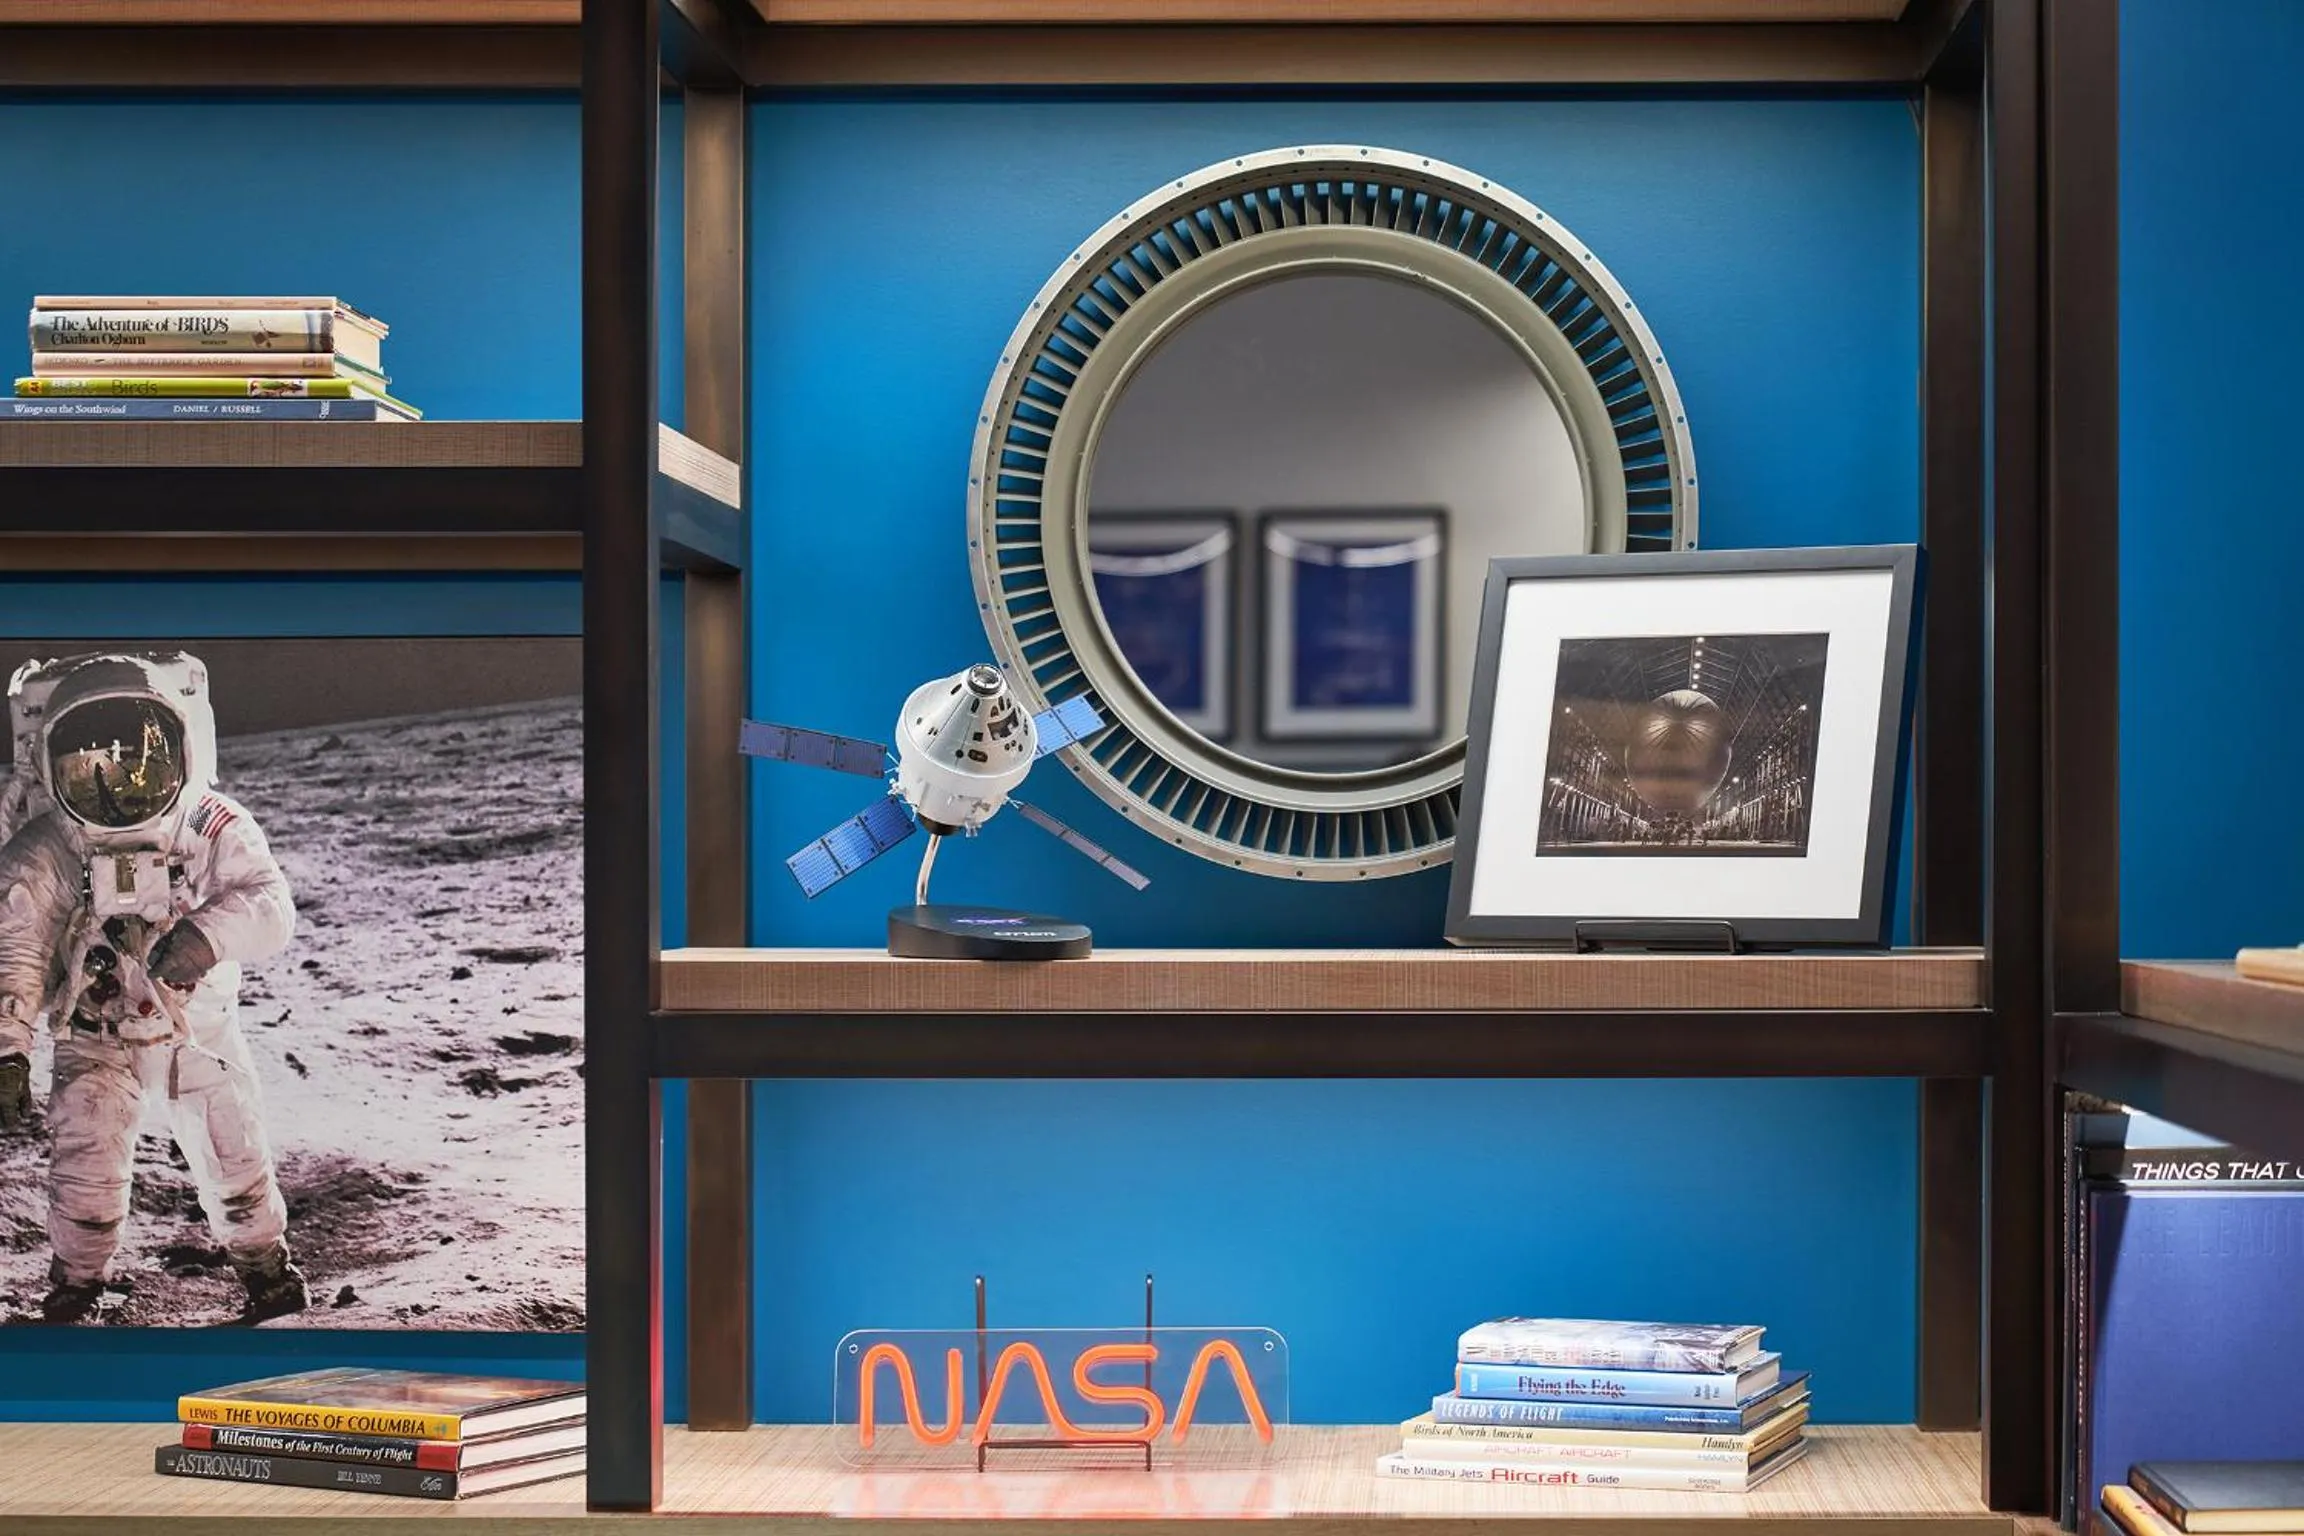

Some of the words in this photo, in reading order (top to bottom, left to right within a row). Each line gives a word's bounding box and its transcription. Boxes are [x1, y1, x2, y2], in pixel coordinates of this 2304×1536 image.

[50, 316, 79, 331] The
[83, 316, 153, 331] Adventure
[155, 317, 169, 331] of
[178, 317, 229, 335] BIRDS
[111, 379, 158, 394] Birds
[14, 404, 43, 416] Wings
[45, 406, 57, 414] on
[59, 404, 74, 414] the
[75, 404, 126, 414] Southwind
[173, 404, 210, 413] DANIEL
[221, 405, 262, 414] RUSSELL
[2132, 1162, 2221, 1180] THINGS
[2228, 1162, 2292, 1180] THAT
[859, 1339, 1276, 1448] NASA
[1518, 1376, 1562, 1396] Flying
[1565, 1378, 1588, 1395] the
[1590, 1379, 1627, 1399] Edge
[189, 1407, 219, 1419] LEWIS
[226, 1408, 254, 1423] THE
[255, 1409, 321, 1428] VOYAGES
[323, 1414, 346, 1430] OF
[348, 1416, 427, 1434] COLUMBIA
[1441, 1402, 1494, 1418] LEGENDS
[1499, 1404, 1515, 1420] OF
[1520, 1405, 1565, 1421] FLIGHT
[1413, 1425, 1440, 1435] Birds
[1442, 1426, 1454, 1438] of
[1456, 1426, 1488, 1438] North
[1491, 1428, 1534, 1440] America
[217, 1430, 284, 1449] Milestones
[285, 1441, 298, 1453] of
[296, 1441, 312, 1452] the
[311, 1441, 336, 1454] First
[334, 1444, 374, 1460] Century
[372, 1447, 385, 1461] of
[383, 1447, 413, 1462] Flight
[1560, 1447, 1633, 1460] AIRCRAFT
[1701, 1437, 1745, 1452] Hamlyn
[175, 1454, 272, 1480] ASTRONAUTS
[1390, 1464, 1411, 1475] The
[1413, 1466, 1456, 1478] Military
[1460, 1469, 1484, 1479] Jets
[1490, 1468, 1579, 1485] Aircraft
[1586, 1474, 1620, 1485] Guide
